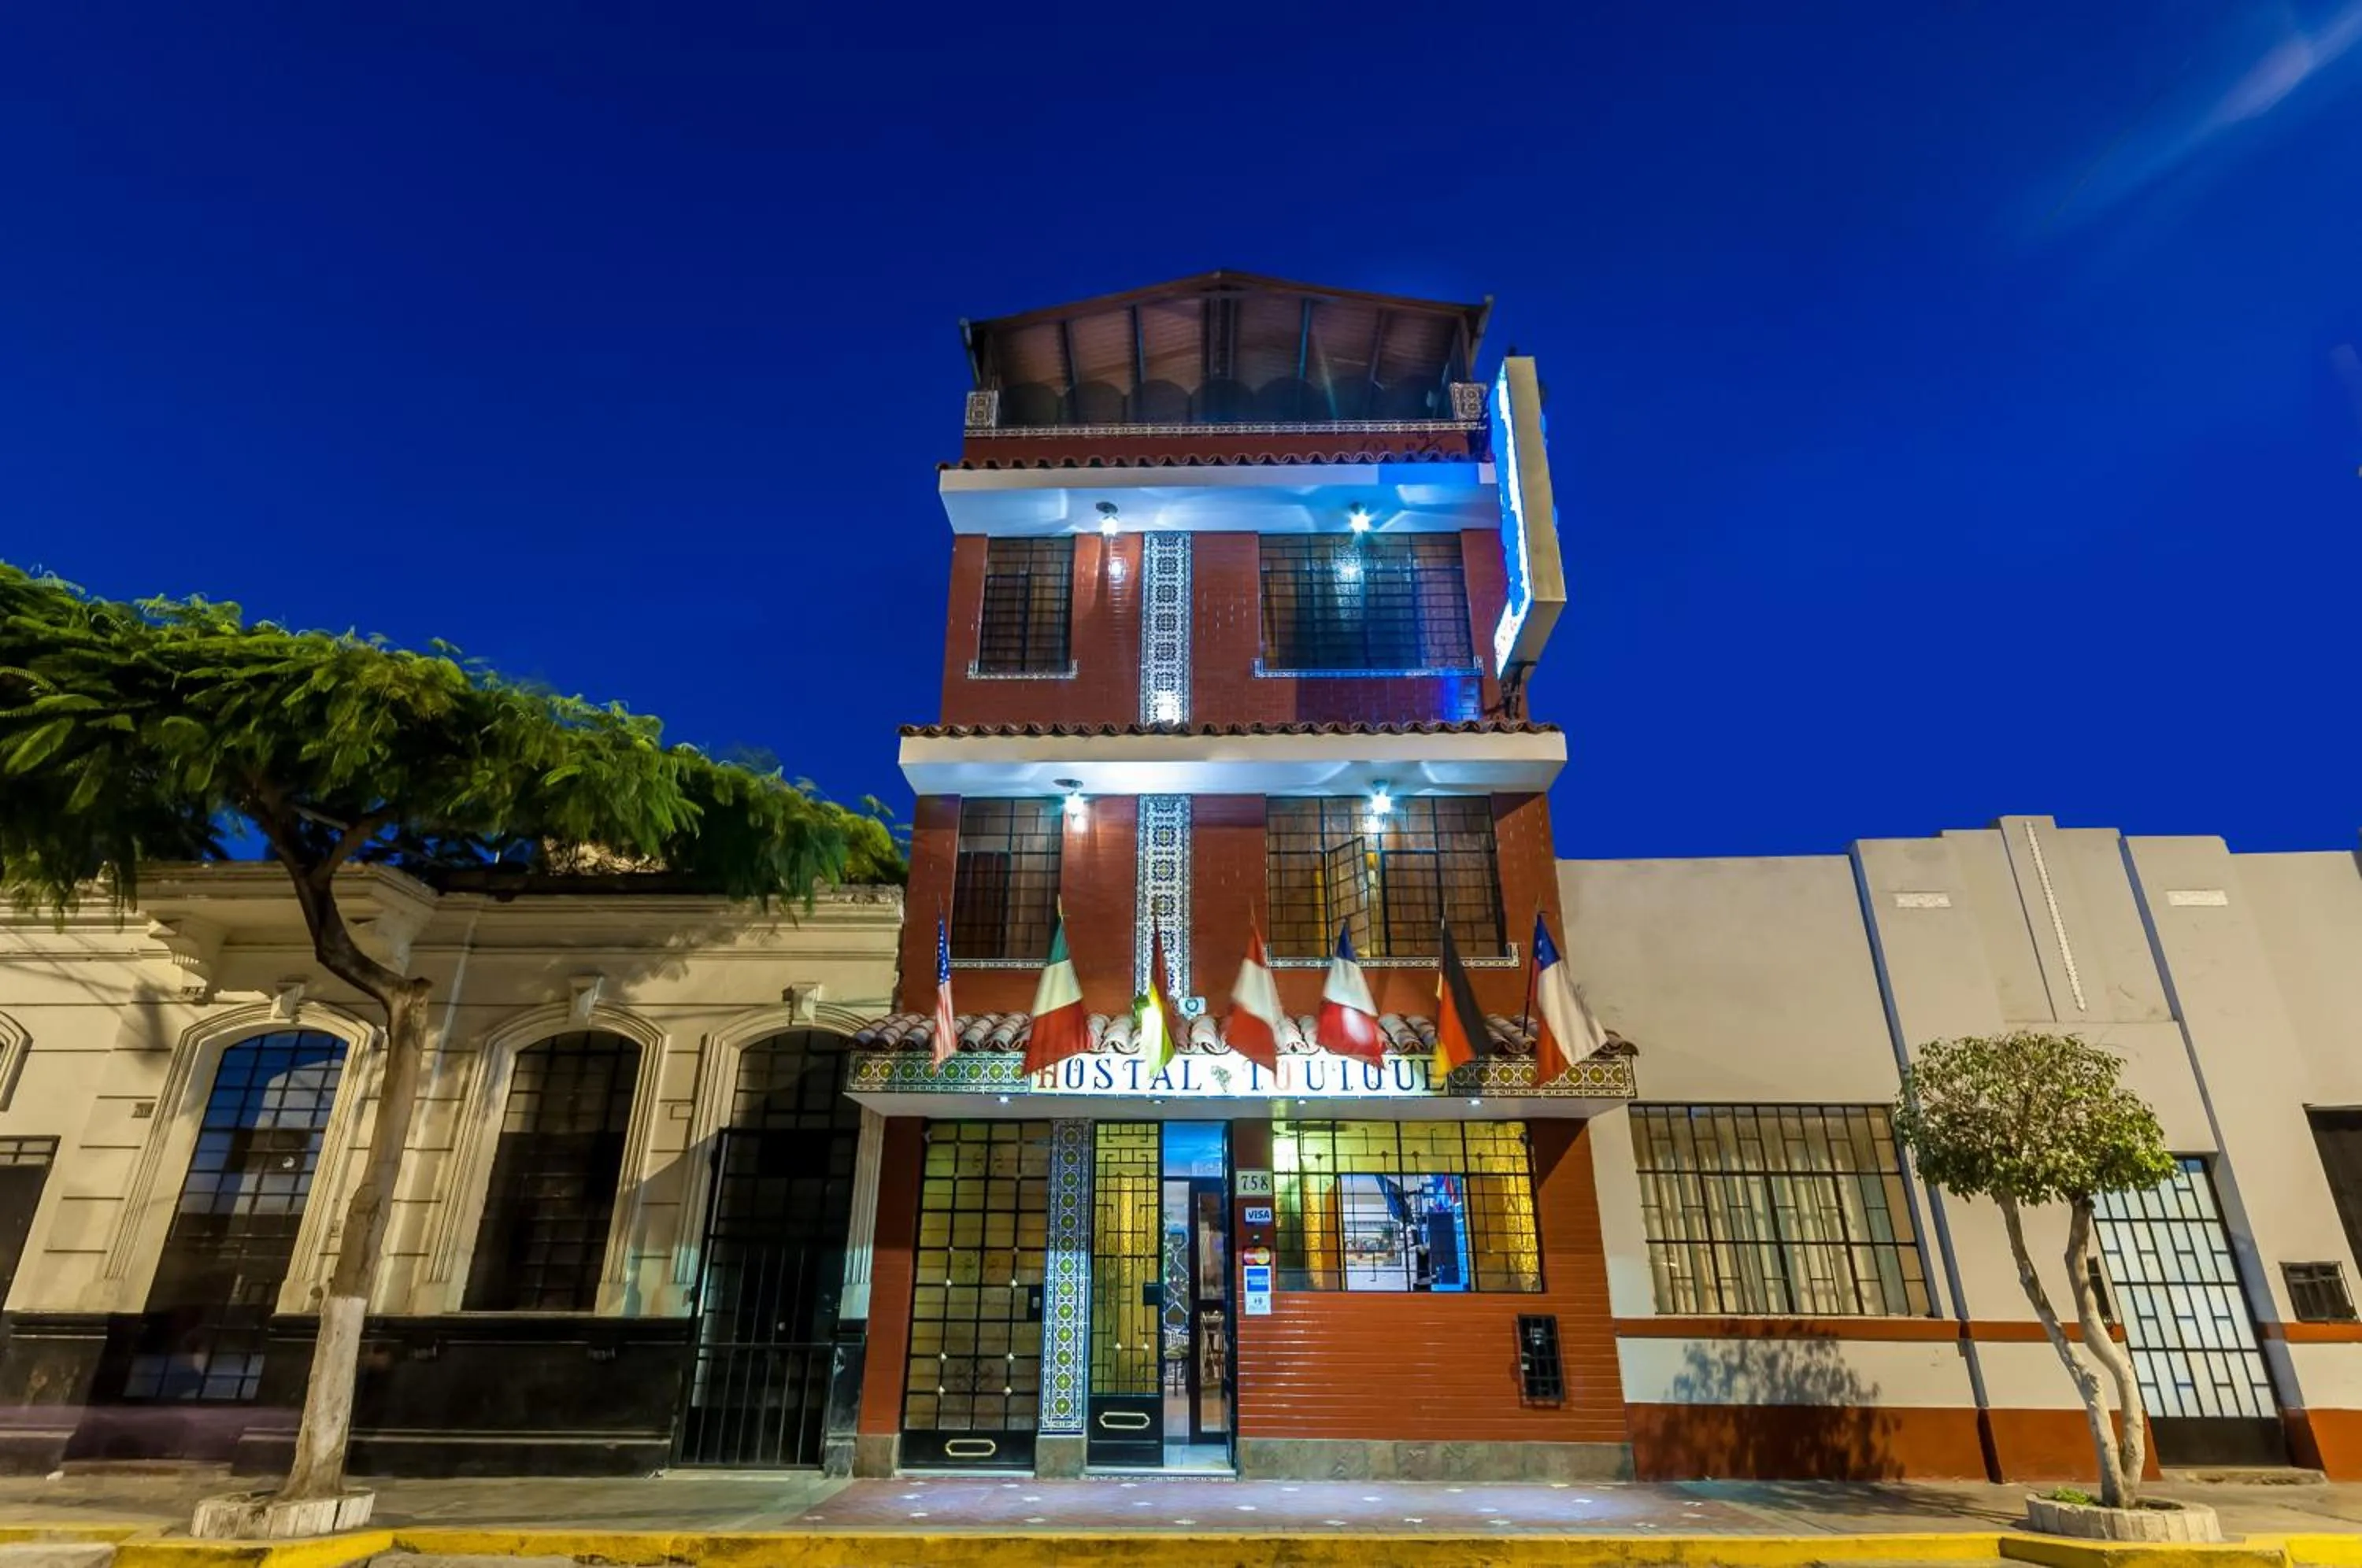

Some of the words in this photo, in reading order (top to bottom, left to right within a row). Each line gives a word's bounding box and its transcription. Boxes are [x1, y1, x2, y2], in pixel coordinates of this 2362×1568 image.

[1035, 1057, 1202, 1090] HOSTAL
[1241, 1175, 1268, 1191] 758
[1248, 1210, 1270, 1219] VISA
